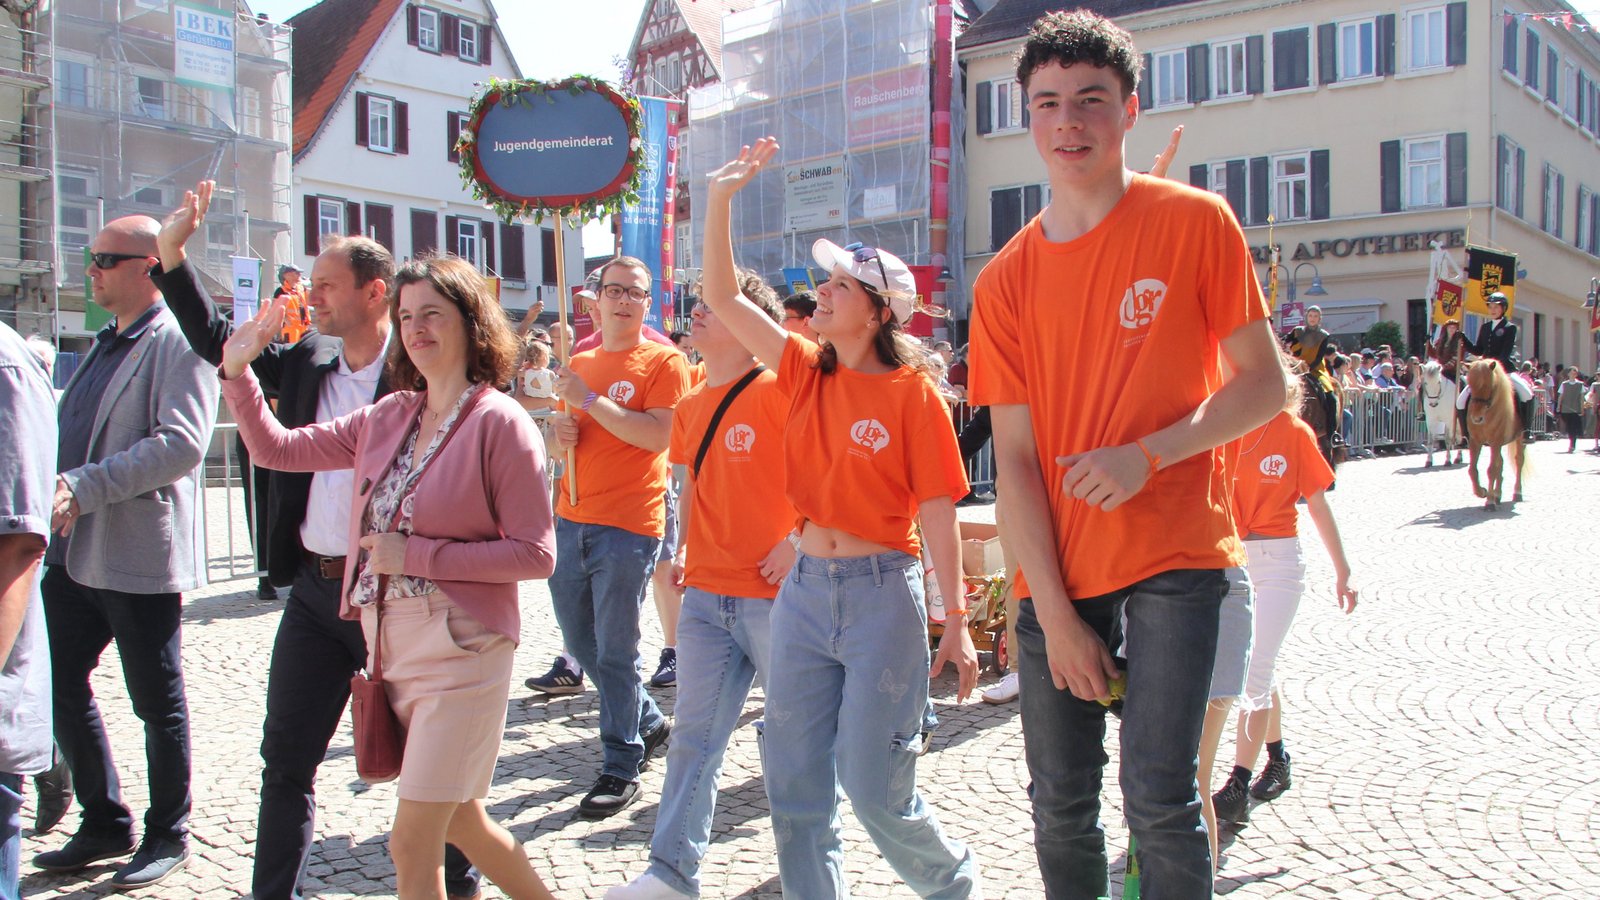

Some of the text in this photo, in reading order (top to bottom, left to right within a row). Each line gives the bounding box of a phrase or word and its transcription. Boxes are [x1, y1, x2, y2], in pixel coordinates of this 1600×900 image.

[176, 10, 231, 37] IBEK
[854, 85, 925, 108] Rauschenberg
[493, 135, 614, 154] Jugendgemeinderat
[1290, 228, 1466, 261] APOTHEKE
